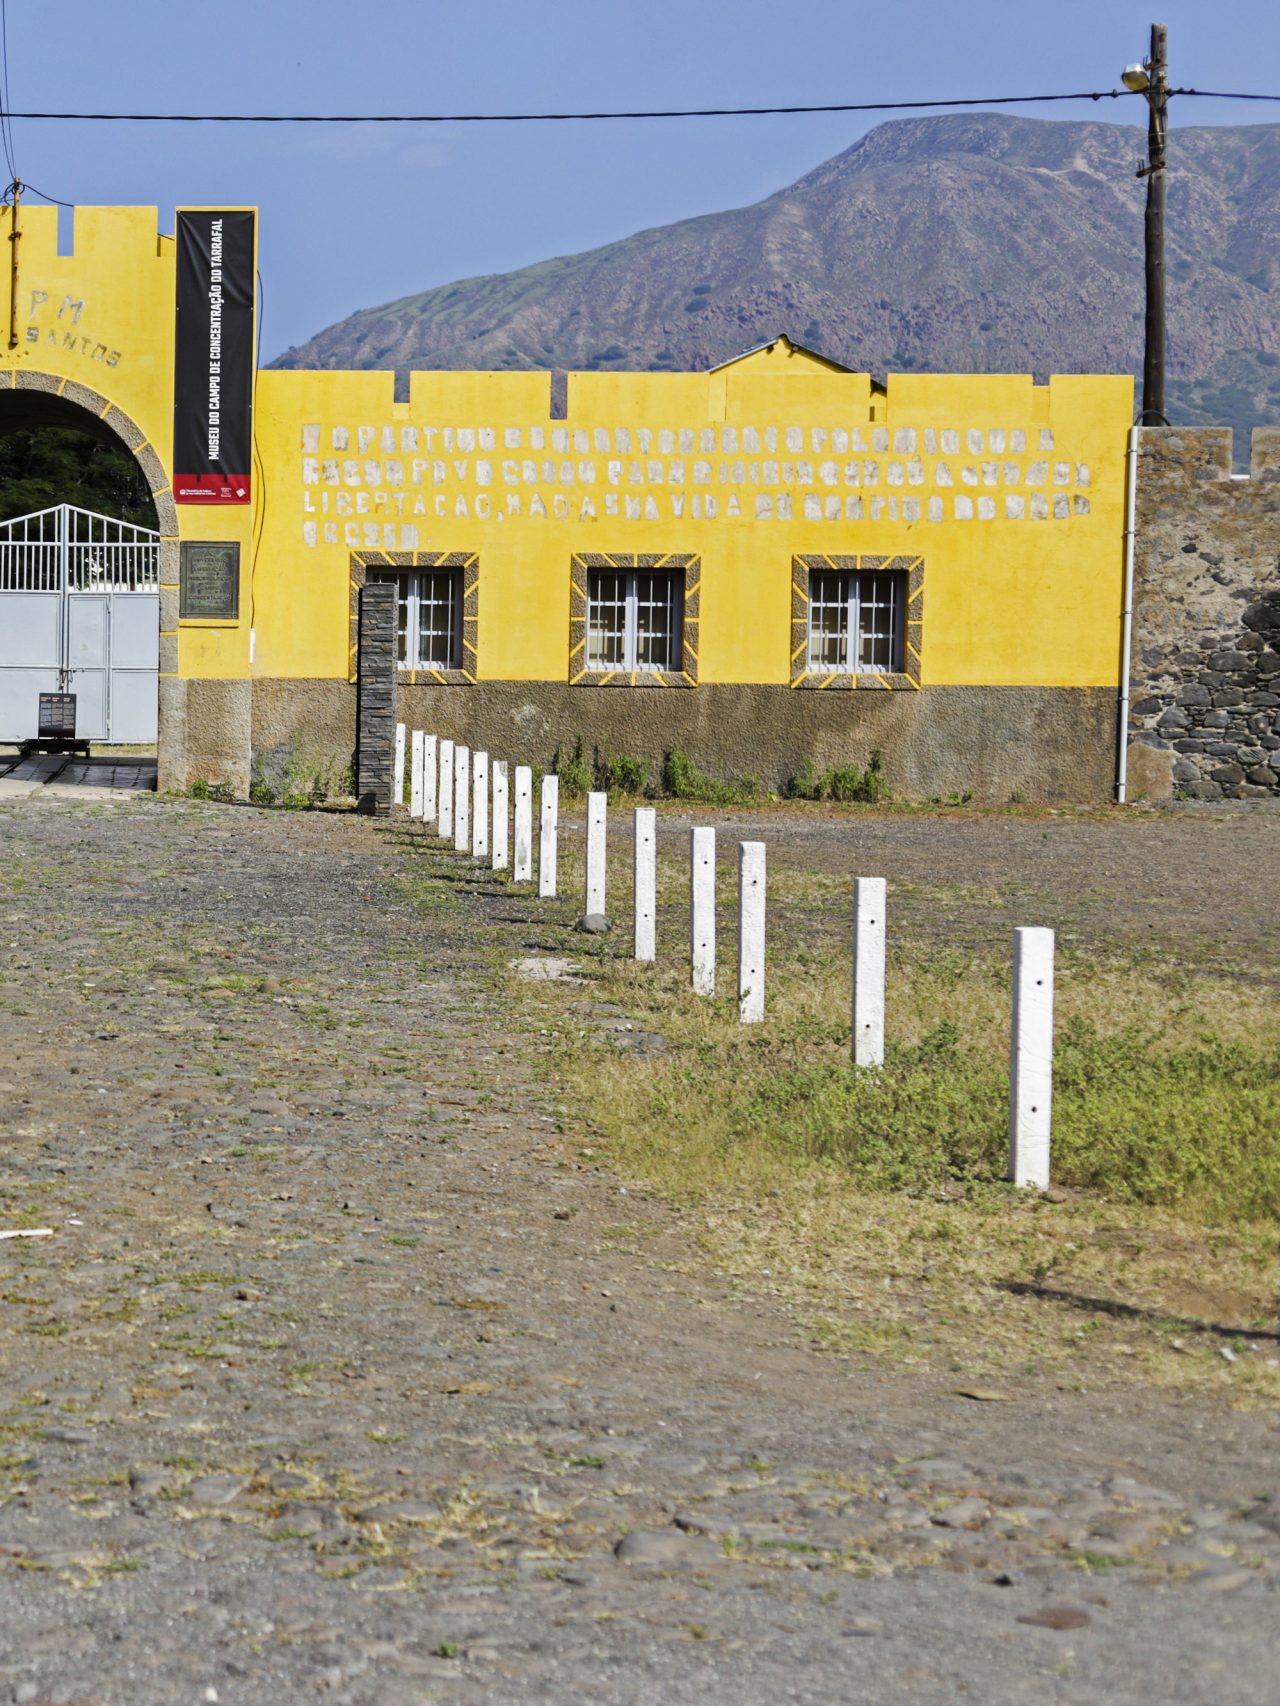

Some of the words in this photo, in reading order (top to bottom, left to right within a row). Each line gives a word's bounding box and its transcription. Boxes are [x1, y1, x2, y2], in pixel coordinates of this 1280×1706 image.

[211, 218, 223, 268] TARRAFAL
[211, 269, 222, 283] DO
[209, 285, 224, 360] CONCENTRAÇÃO
[25, 326, 123, 368] SANTOS
[209, 361, 221, 374] DE
[209, 376, 221, 410] CAMPO
[208, 411, 220, 425] DO
[208, 427, 220, 460] MUSEU
